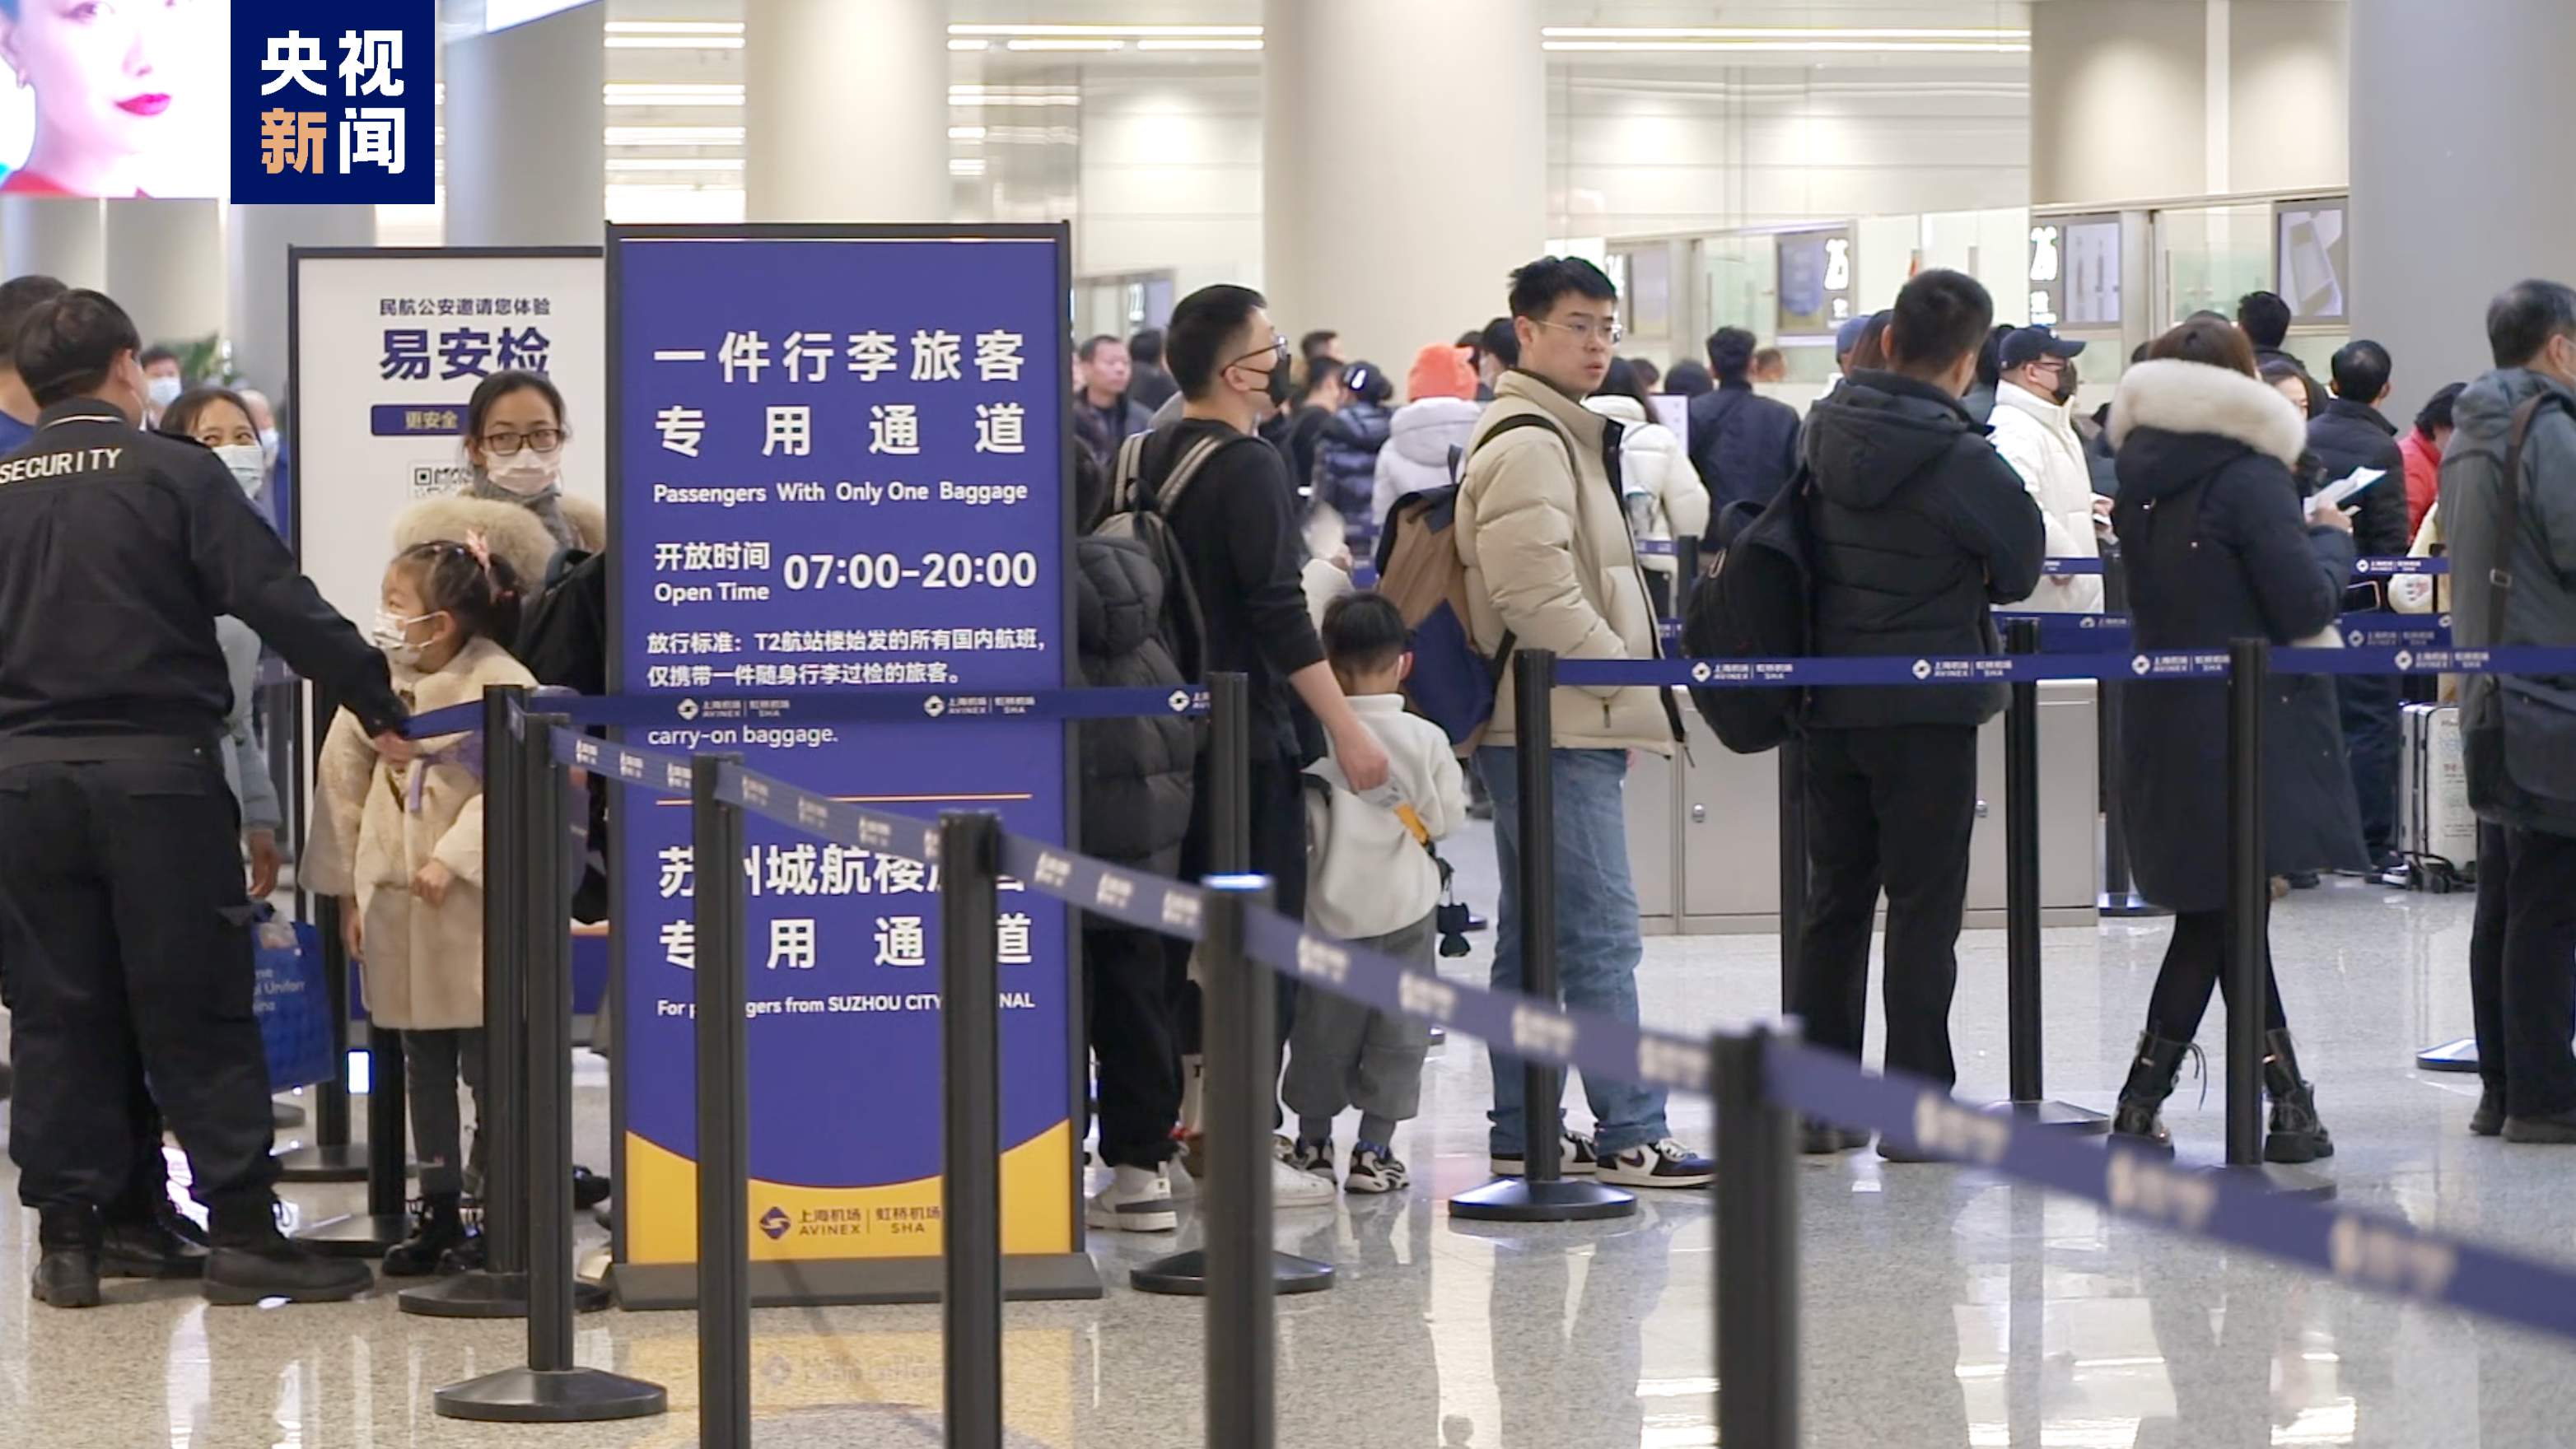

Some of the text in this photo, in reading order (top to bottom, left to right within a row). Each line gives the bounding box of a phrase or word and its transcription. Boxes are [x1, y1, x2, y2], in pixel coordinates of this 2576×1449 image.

[380, 297, 550, 317] 民航公安邀请您体验
[380, 326, 550, 380] 易安检
[654, 328, 1024, 383] 一件行李旅客
[655, 402, 1025, 457] 专用通道
[0, 447, 123, 484] SECURITY
[653, 481, 1028, 508] Passengers With Only One Baggage
[654, 541, 770, 571] 开放时间
[654, 581, 771, 607] Open Time
[647, 724, 838, 750] carry-on baggage.
[657, 999, 686, 1016] For
[785, 996, 824, 1013] from
[828, 994, 902, 1013] SUZHOU
[904, 993, 942, 1011] CITY
[797, 1205, 941, 1223] 上海机场 虹桥机场
[797, 1222, 925, 1237] AVINEX SHA
